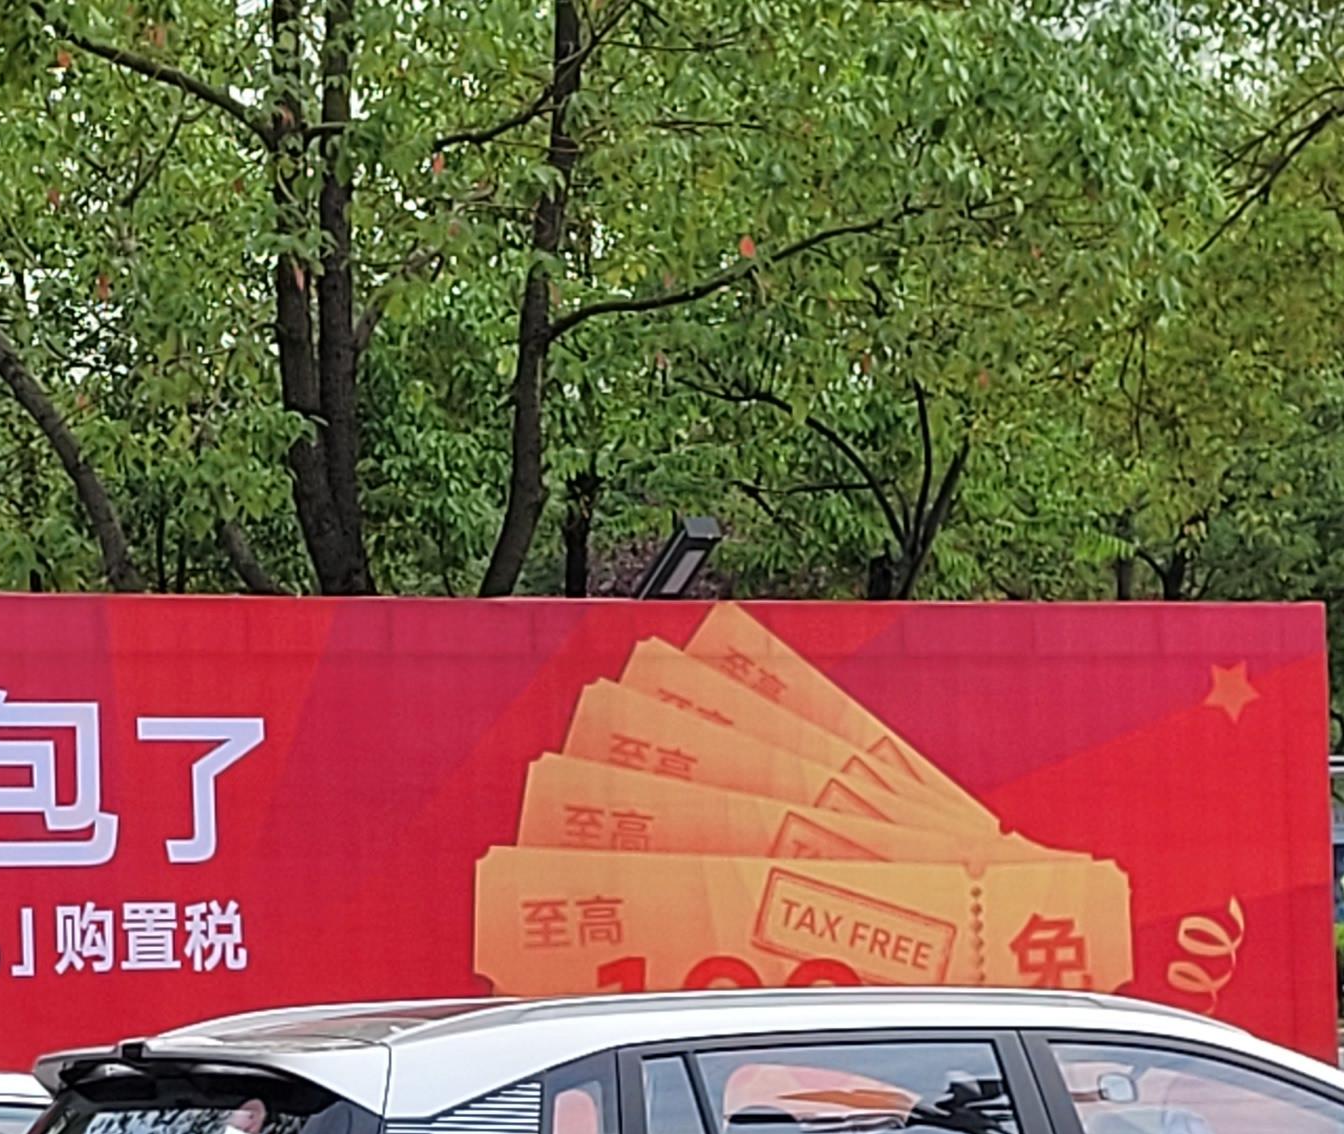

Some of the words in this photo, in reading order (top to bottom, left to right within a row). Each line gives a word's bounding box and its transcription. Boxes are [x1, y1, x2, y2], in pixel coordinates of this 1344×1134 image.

[521, 895, 625, 950] 至高
[780, 898, 844, 943] TAX
[848, 920, 934, 973] FREE
